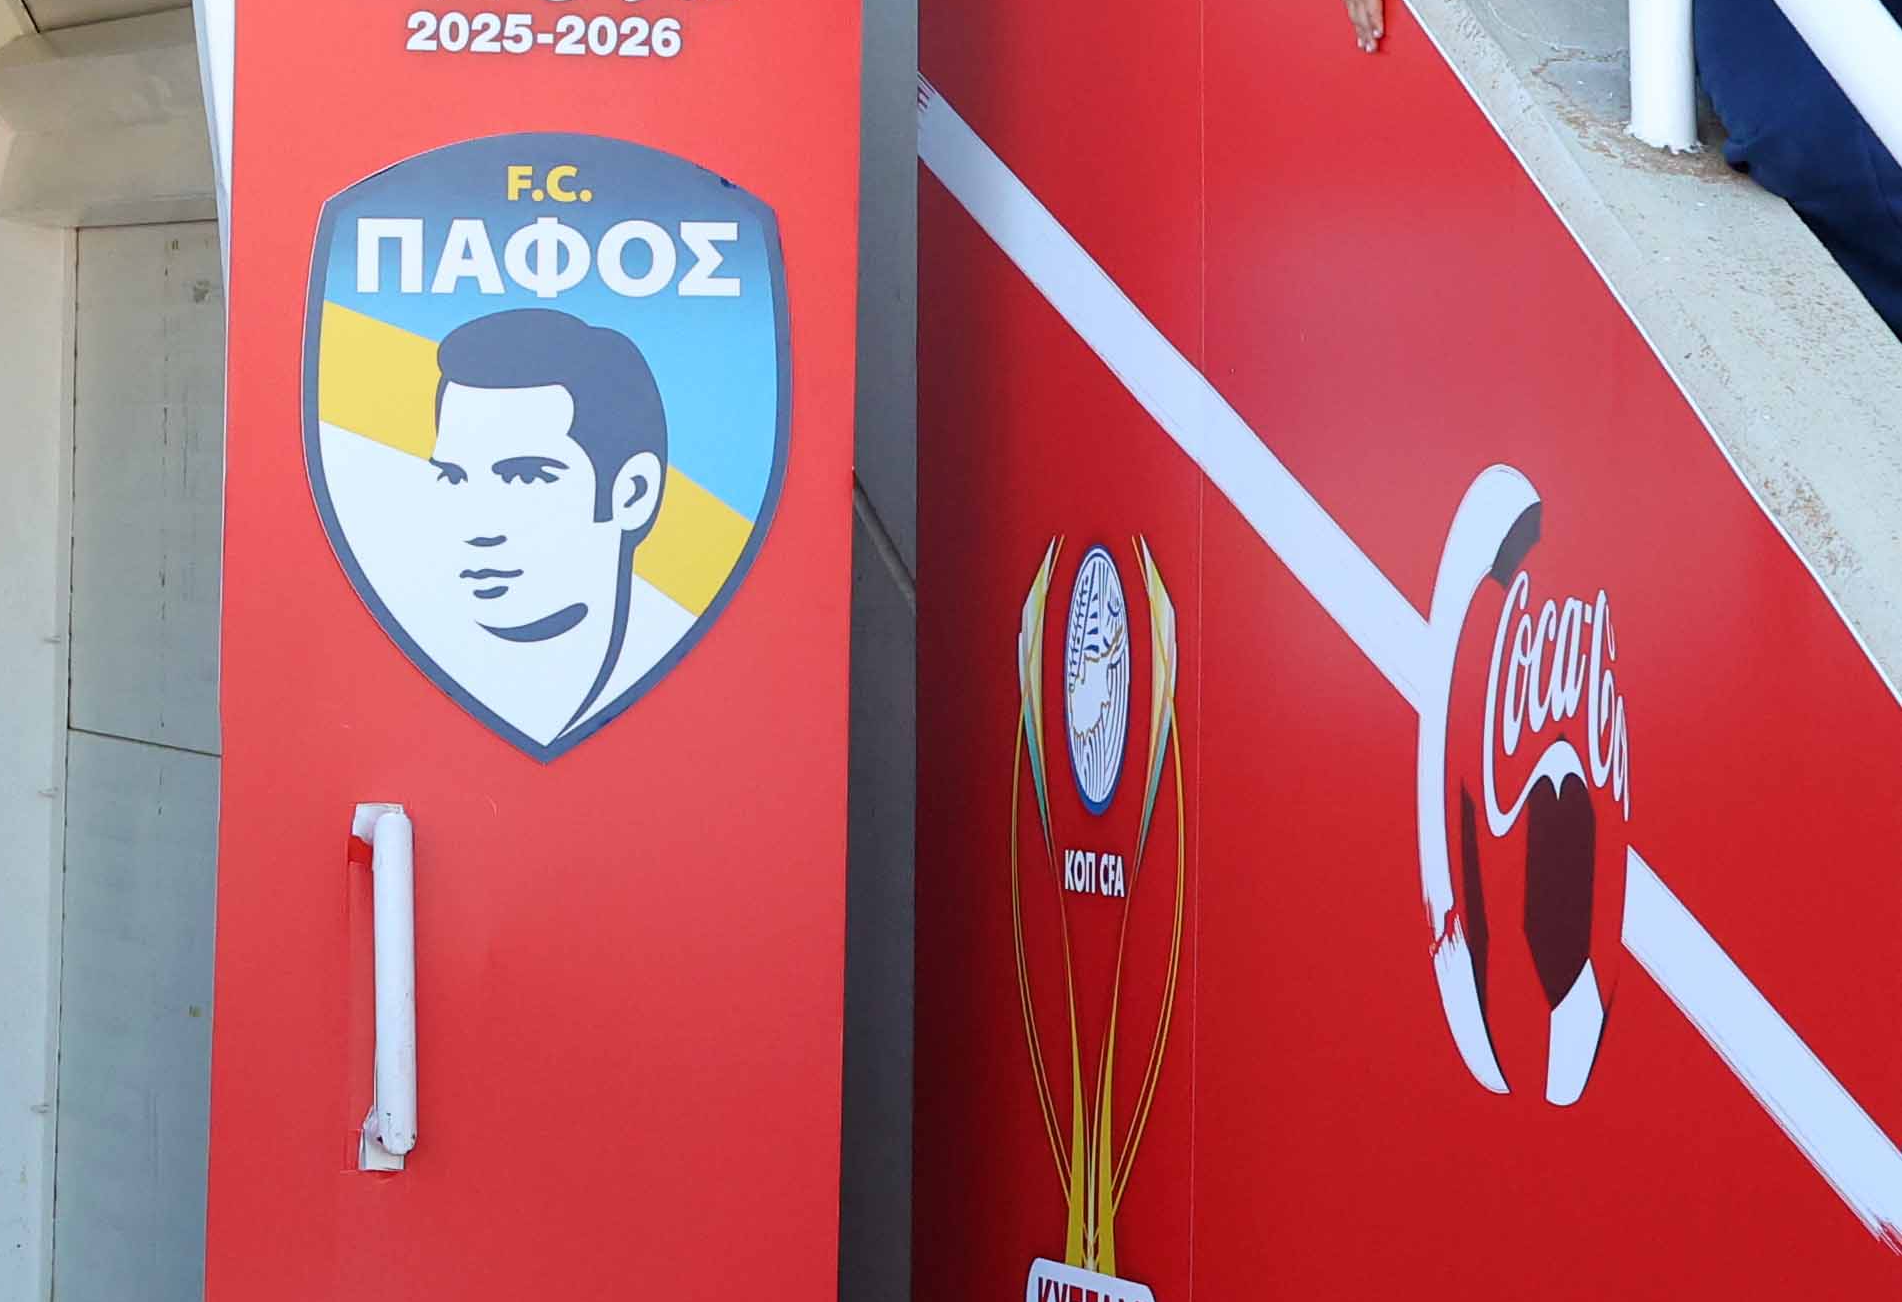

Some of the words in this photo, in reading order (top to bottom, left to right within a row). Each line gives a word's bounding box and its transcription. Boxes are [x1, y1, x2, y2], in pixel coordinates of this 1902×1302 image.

[405, 11, 683, 58] 2025-2026
[506, 164, 594, 202] F.C.
[355, 216, 742, 299] ΠΑΦΟΣ
[1064, 849, 1097, 895] ΚΟΠ
[1099, 853, 1126, 899] CFA
